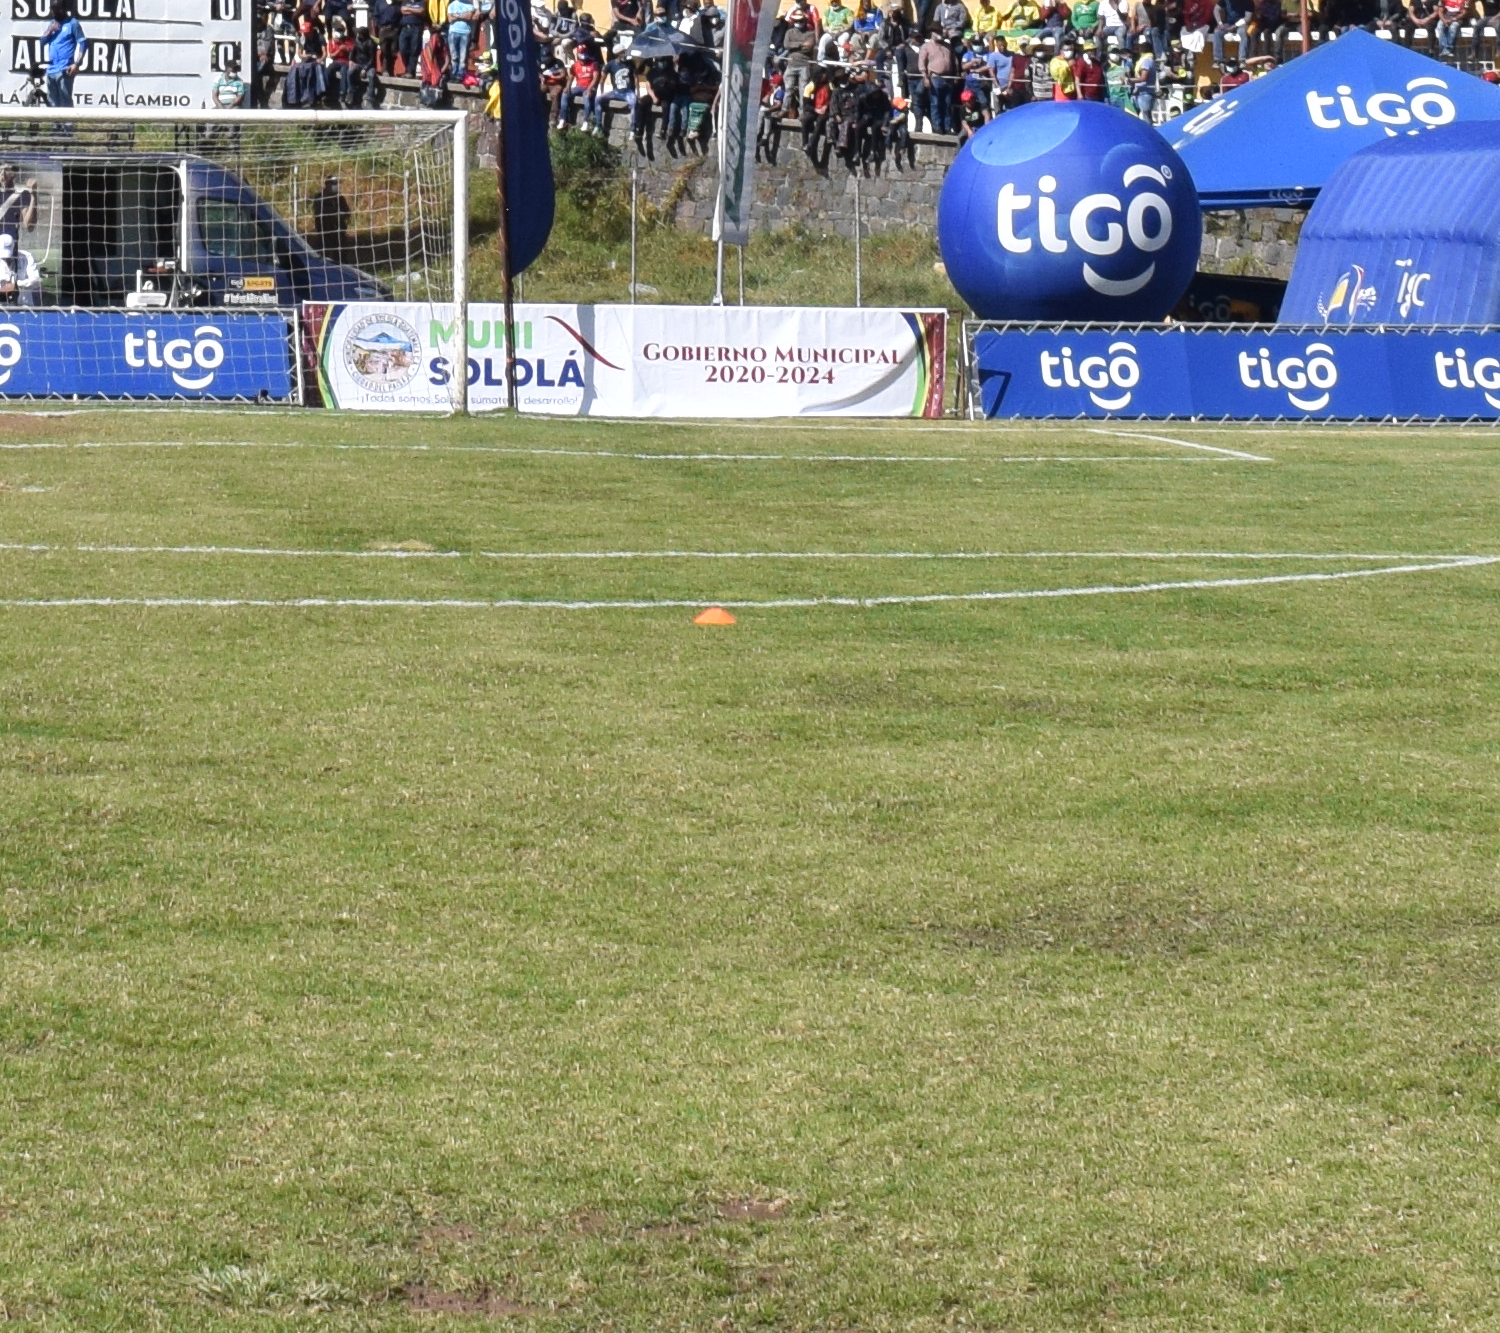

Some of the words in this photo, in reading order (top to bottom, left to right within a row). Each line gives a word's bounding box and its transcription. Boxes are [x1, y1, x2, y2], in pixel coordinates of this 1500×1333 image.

[99, 94, 118, 106] AL
[125, 95, 191, 107] CAMBIO
[1305, 78, 1457, 128] tigo
[998, 164, 1173, 256] tigo
[124, 325, 224, 371] tigo
[429, 349, 585, 388] SOLOLÁ
[643, 343, 767, 362] GOBIERNO
[774, 345, 904, 365] MUNICIPAL
[1040, 341, 1140, 390] tigo
[1238, 343, 1338, 390] tigo
[705, 365, 836, 384] 2020-2024
